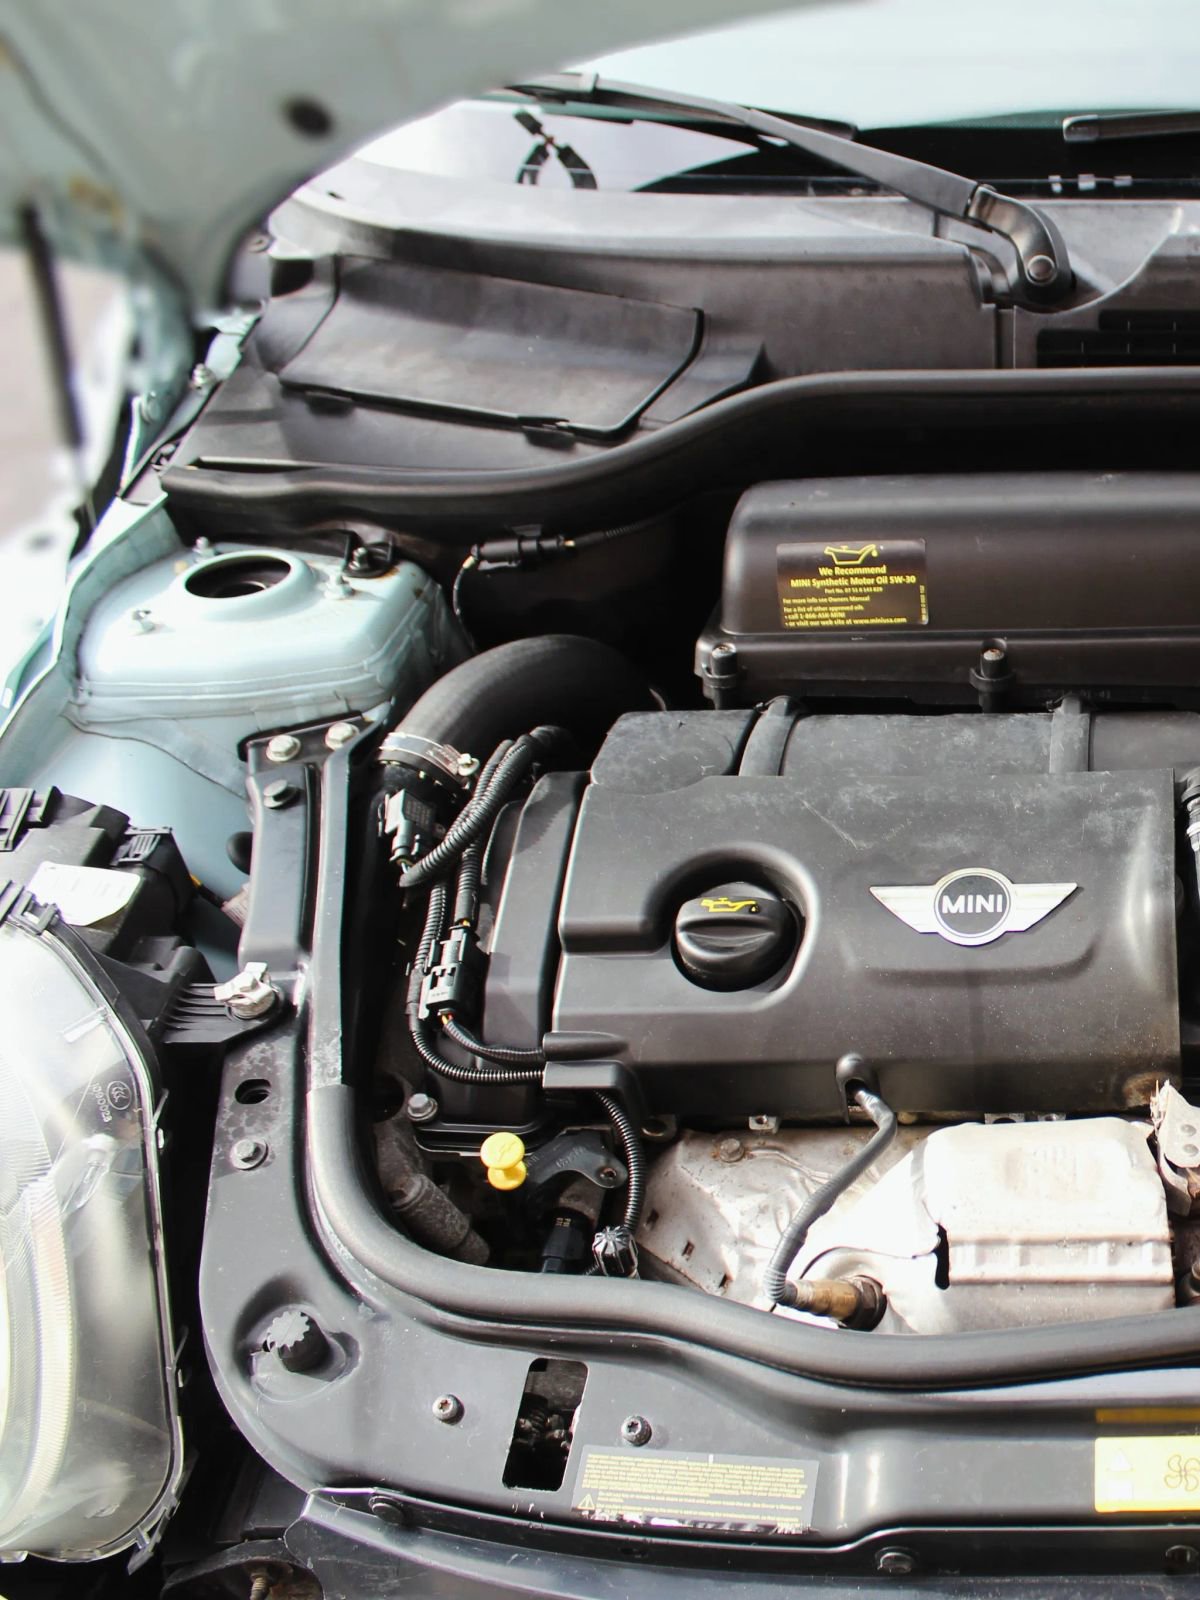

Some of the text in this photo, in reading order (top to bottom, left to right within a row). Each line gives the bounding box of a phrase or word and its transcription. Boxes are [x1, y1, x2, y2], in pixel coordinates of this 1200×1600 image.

[819, 565, 886, 576] We Recommend
[791, 575, 916, 588] MINI Synthetic Motor Oil 5W-30
[942, 894, 1003, 914] MINI
